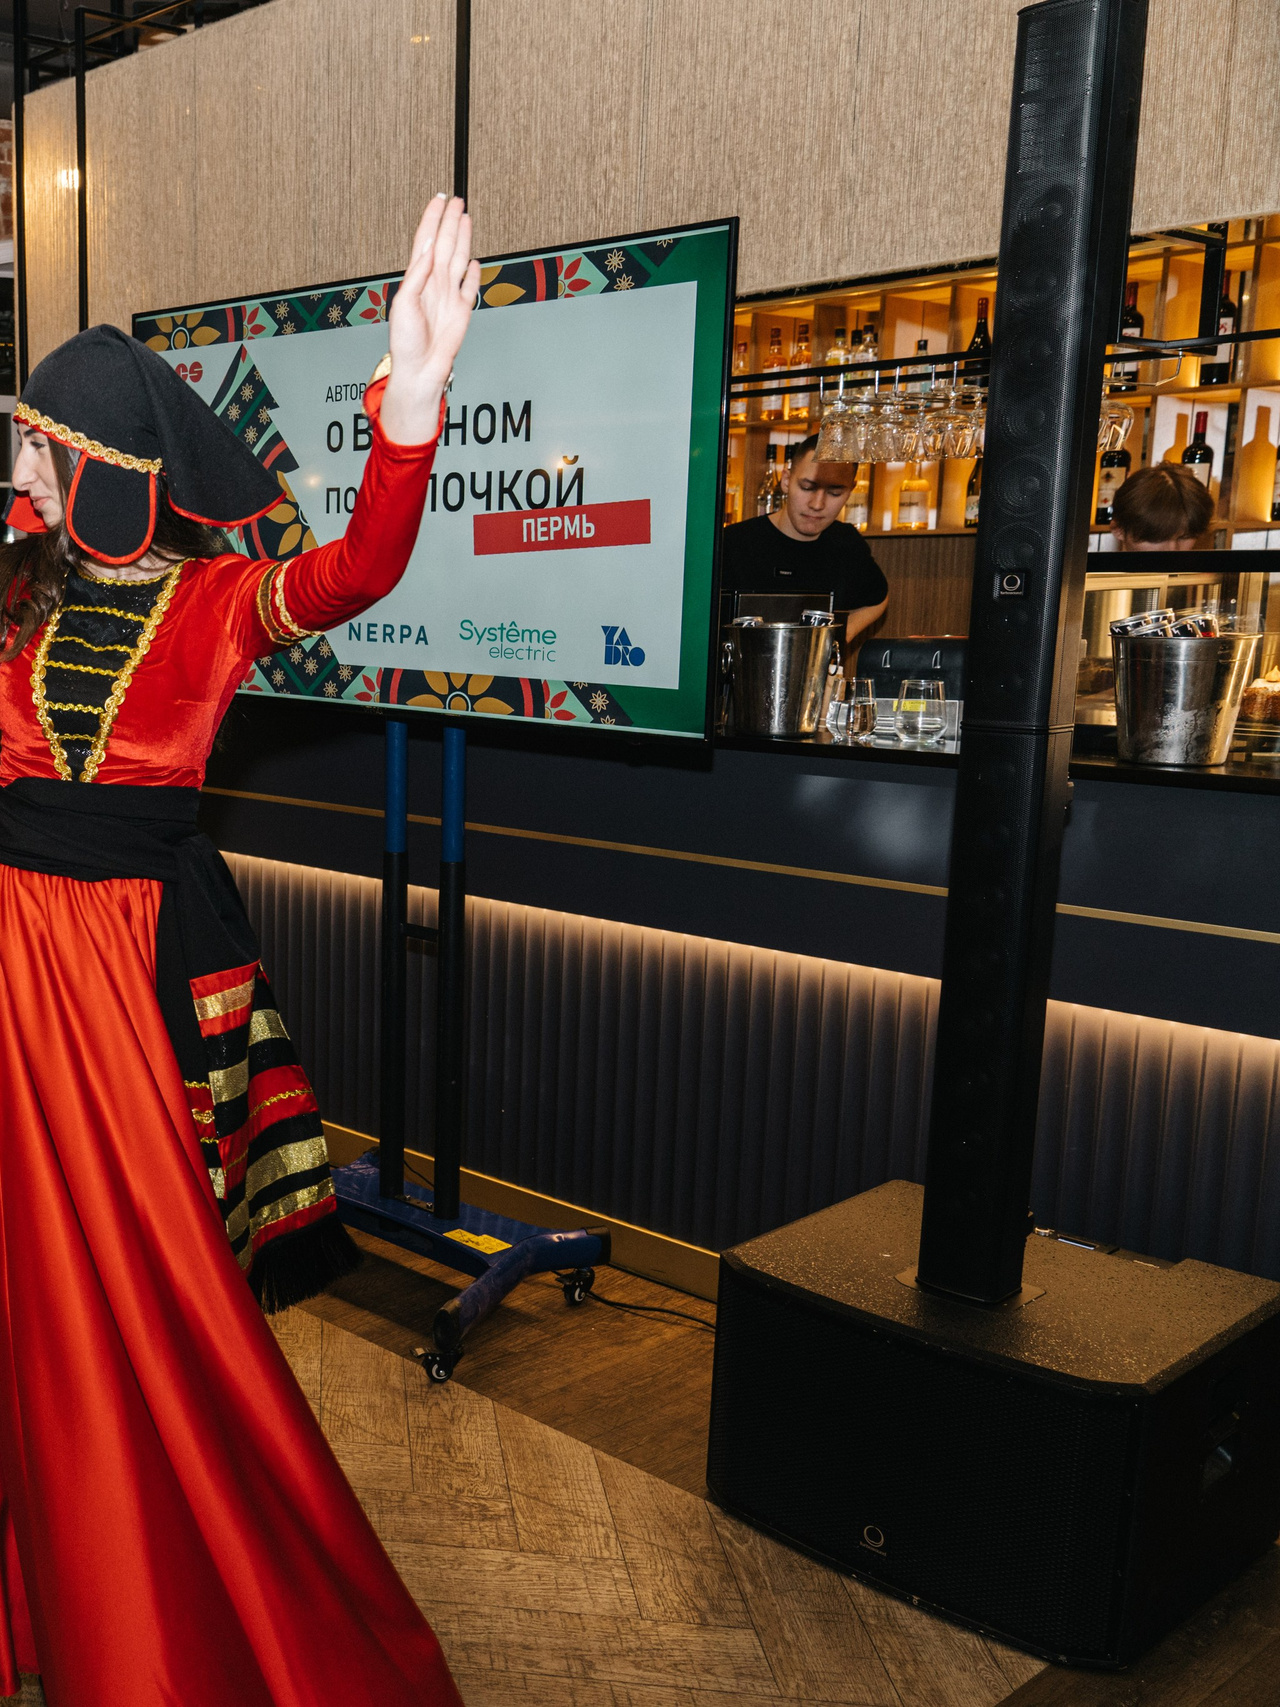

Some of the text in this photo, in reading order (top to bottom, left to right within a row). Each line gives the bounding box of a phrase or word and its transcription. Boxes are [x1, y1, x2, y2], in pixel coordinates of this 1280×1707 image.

[325, 382, 367, 403] АВТОР
[326, 400, 532, 453] о ВНОМ
[325, 455, 585, 514] по ОЧКОЙ
[522, 513, 596, 543] ПЕРМЬ
[347, 621, 429, 646] NERPA
[458, 618, 558, 647] Systême
[488, 642, 557, 663] electric
